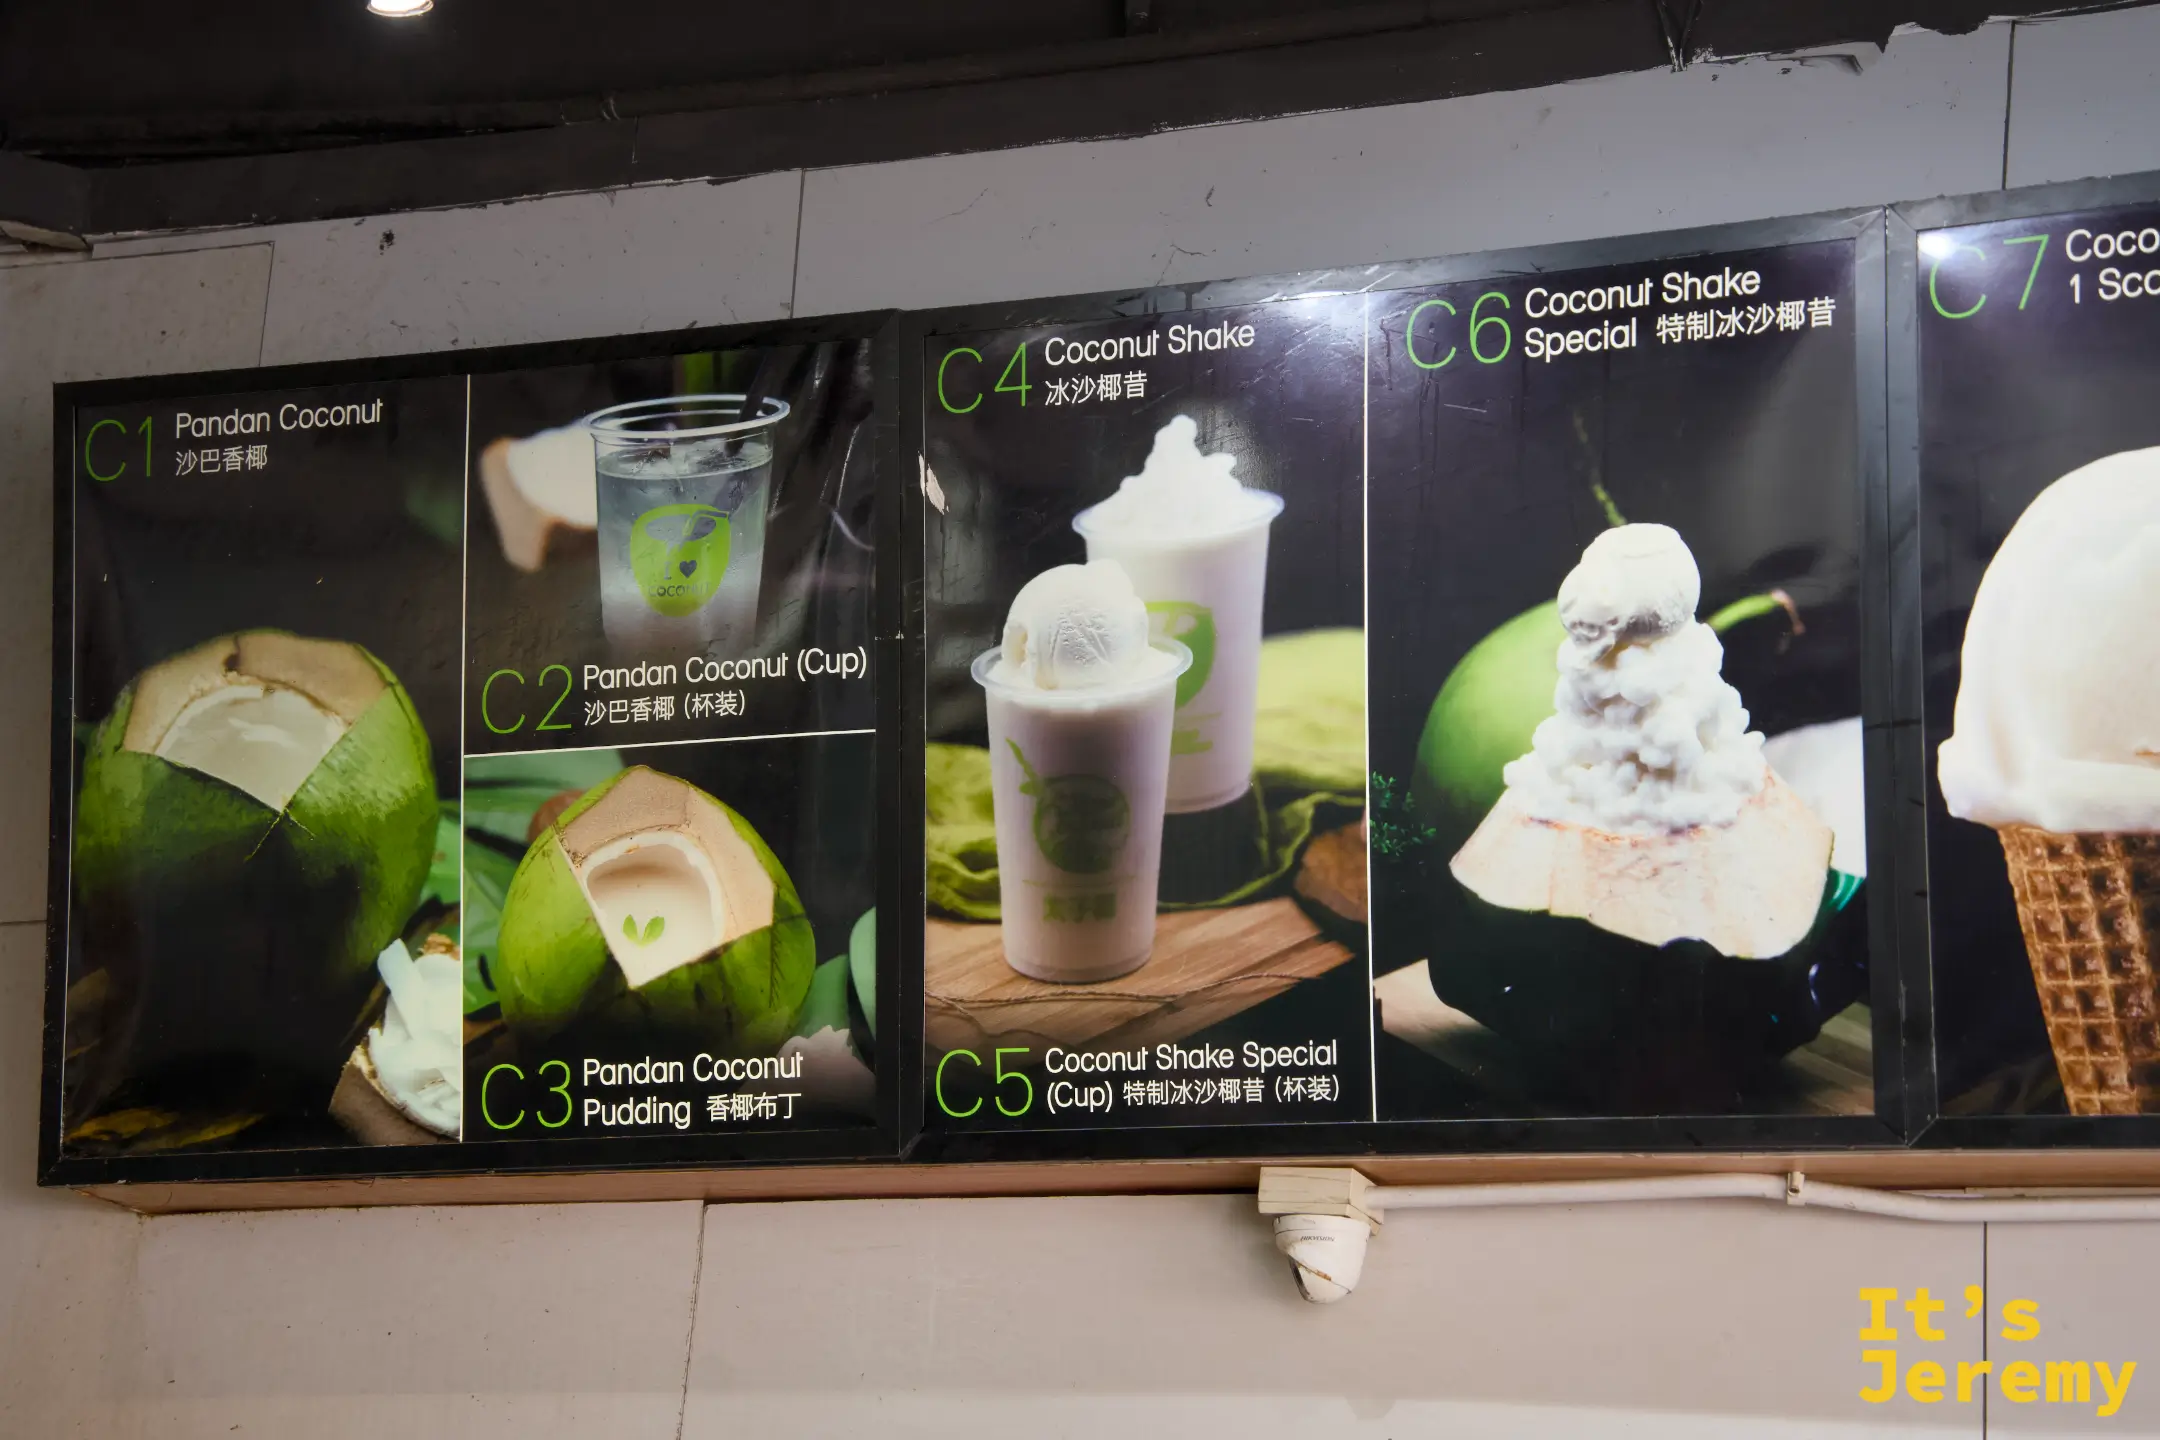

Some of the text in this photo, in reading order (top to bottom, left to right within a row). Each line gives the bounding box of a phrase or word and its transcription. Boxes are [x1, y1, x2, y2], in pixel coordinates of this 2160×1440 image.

[1525, 266, 1760, 318] Coconut Shake
[1929, 234, 2049, 318] C7
[2069, 273, 2081, 304] 1
[1045, 321, 1255, 366] Coconut Shake
[1406, 291, 1511, 369] C6
[1524, 296, 1836, 362] Special 特制冰沙椰昔
[938, 342, 1032, 414] C4
[1045, 371, 1148, 406] 冰沙椰昔
[175, 398, 383, 438] Pandan Coconut
[85, 416, 152, 481] C1
[175, 444, 268, 476] 沙巴香椰
[583, 646, 867, 691] Pandan Coconut (Cup)
[481, 664, 573, 735] C2
[584, 695, 675, 726] 沙巴香椰
[583, 1052, 803, 1087] Pandan Coconut
[1045, 1040, 1337, 1074] Coconut Shake Special
[481, 1060, 573, 1129] C3
[935, 1047, 1033, 1118] C5
[1047, 1080, 1113, 1114] (Cup)
[1123, 1077, 1265, 1106] 特制冰沙椰昔
[583, 1092, 802, 1130] Pudding 香椰布丁
